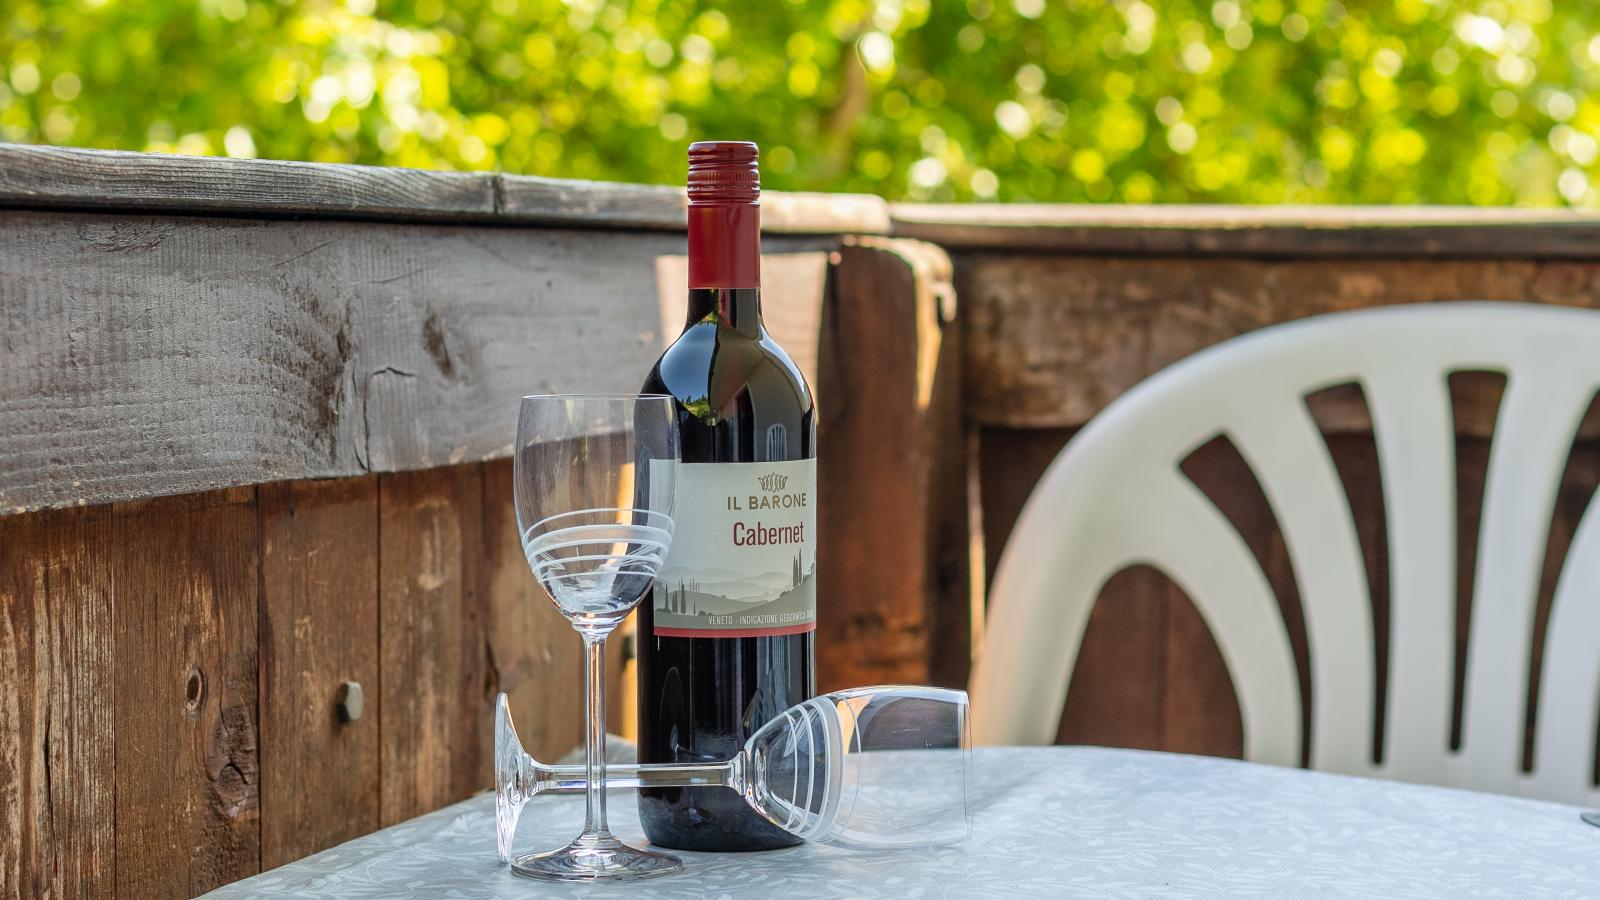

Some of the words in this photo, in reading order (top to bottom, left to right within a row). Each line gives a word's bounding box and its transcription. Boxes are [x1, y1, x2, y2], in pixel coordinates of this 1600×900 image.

[727, 496, 742, 510] IL
[748, 493, 807, 510] BARONE
[733, 521, 805, 546] Cabernet
[708, 615, 733, 624] VENETO
[739, 614, 778, 624] INDICAZIONE
